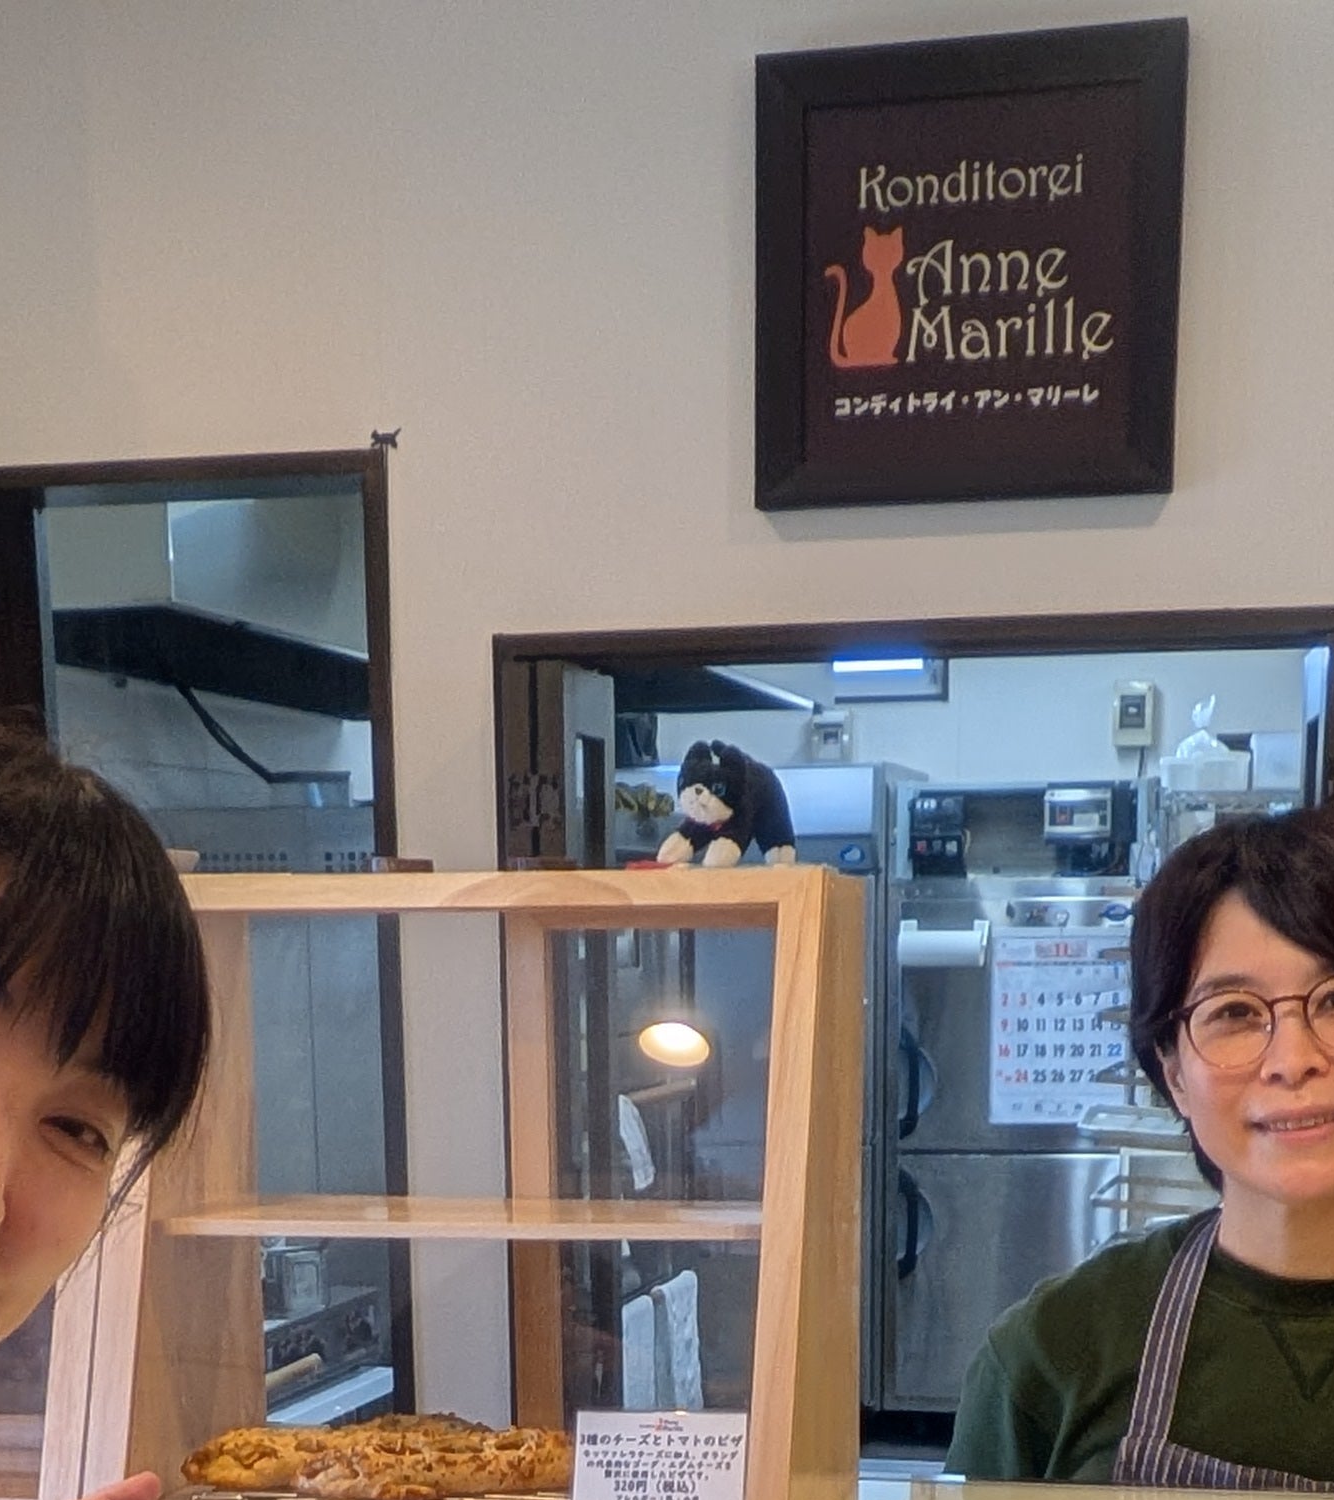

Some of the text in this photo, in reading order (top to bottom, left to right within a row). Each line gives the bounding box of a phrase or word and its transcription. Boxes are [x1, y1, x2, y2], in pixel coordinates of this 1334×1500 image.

[858, 154, 1084, 212] Konditorei
[906, 239, 1069, 304] Anne
[906, 298, 1115, 364] Marille
[834, 385, 1100, 417] コンディトライ・アン・マリーレ
[1037, 993, 1046, 1006] 4
[1056, 993, 1064, 1006] 5
[1074, 993, 1082, 1006] 6
[1092, 993, 1101, 1006] 7
[1016, 1019, 1029, 1032] 10
[1036, 1019, 1046, 1032] 11
[1054, 1019, 1066, 1032] 12
[1072, 1019, 1085, 1032] 13
[1091, 1019, 1103, 1032] 14
[998, 1044, 1123, 1058] 16 17 18 19 20 21 22
[1014, 1069, 1029, 1083] 24
[1033, 1069, 1047, 1083] 25
[1051, 1069, 1066, 1083] 26
[1069, 1069, 1085, 1083] 27
